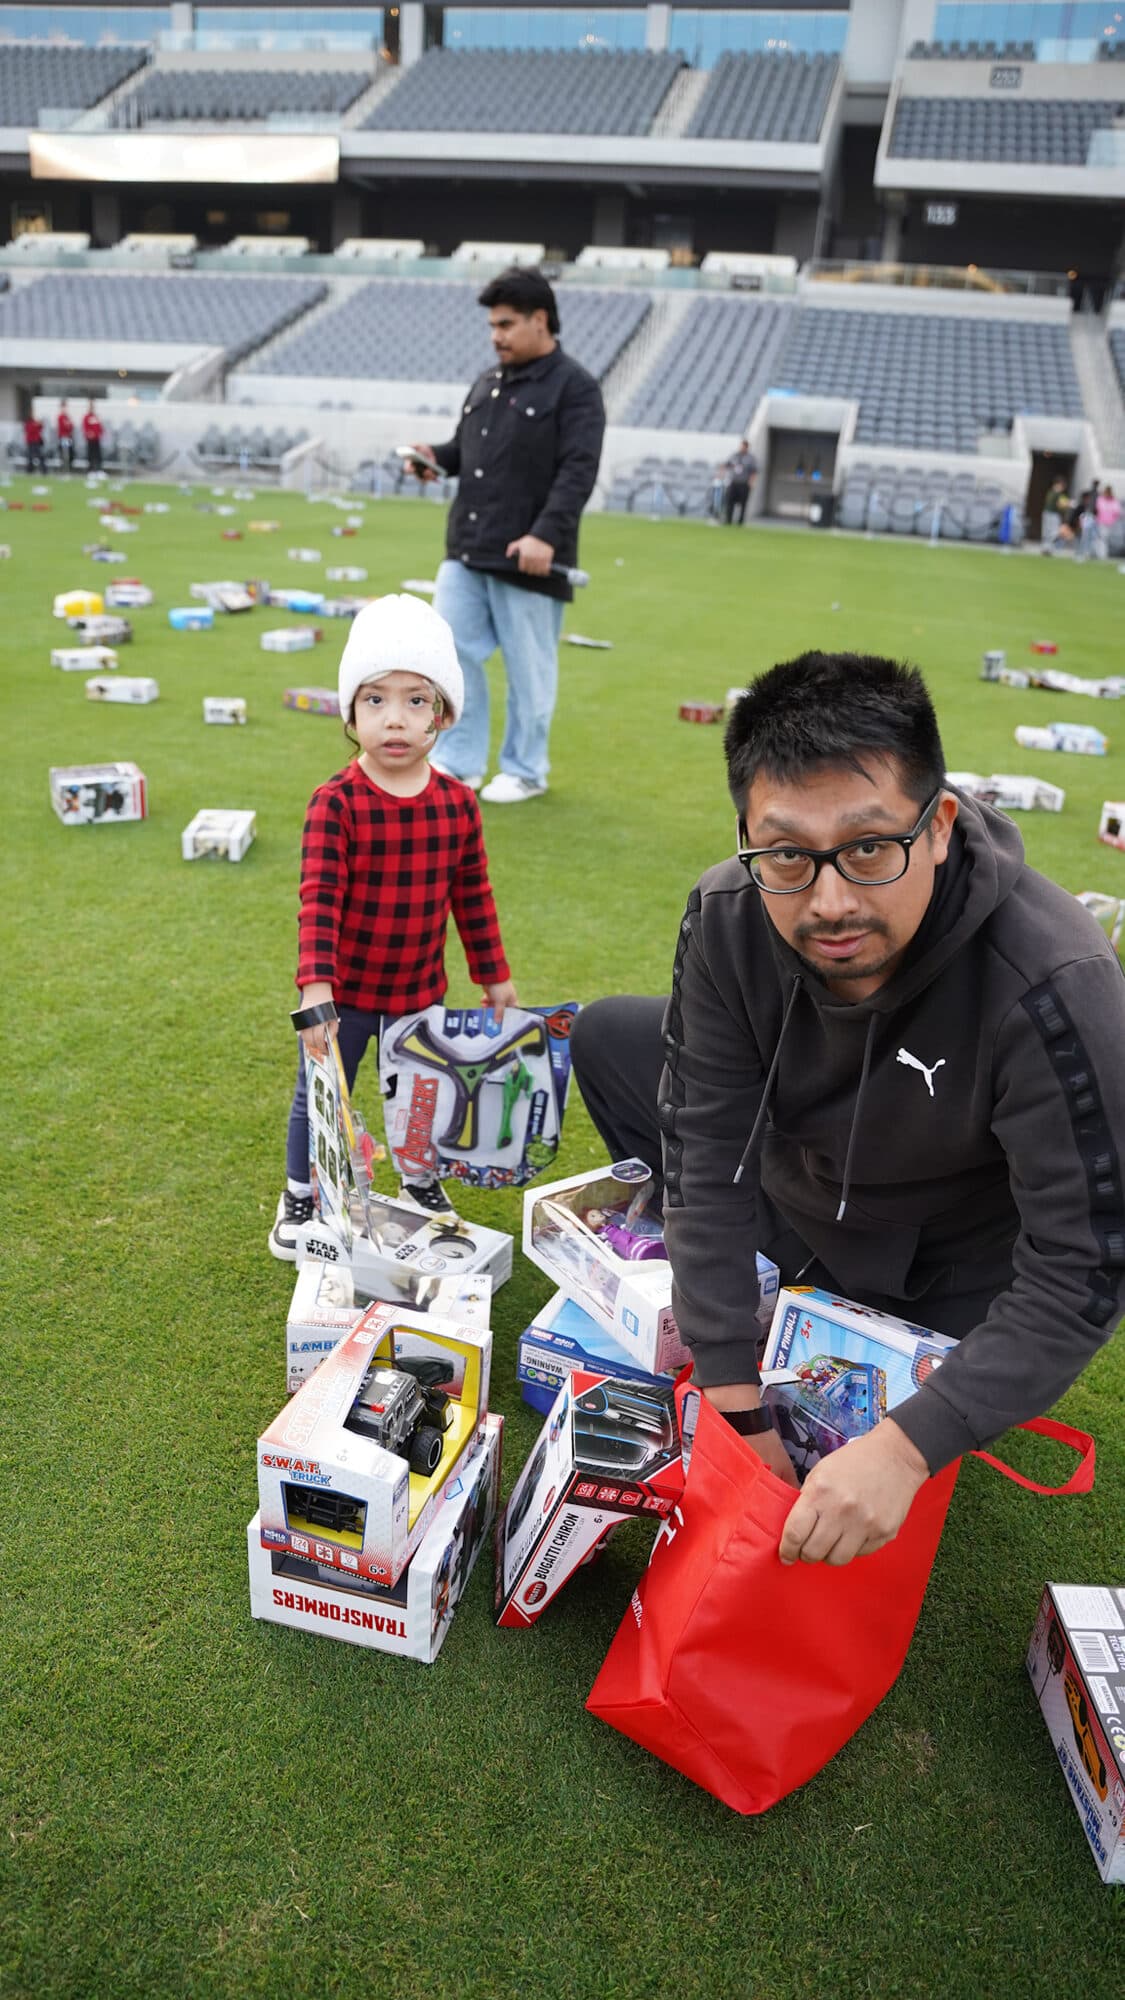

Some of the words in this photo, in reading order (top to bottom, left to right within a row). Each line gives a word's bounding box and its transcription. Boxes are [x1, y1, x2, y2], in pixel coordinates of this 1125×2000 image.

[392, 1072, 440, 1175] AVENGERS
[305, 1239, 339, 1255] STAR
[305, 1246, 338, 1261] WARS
[781, 1311, 797, 1350] PINBALL
[800, 1319, 813, 1339] 3+
[290, 1365, 304, 1374] 6+
[261, 1454, 320, 1475] S.W.A.T.
[290, 1471, 332, 1486] TRUCK
[594, 1514, 603, 1524] 6+
[534, 1545, 561, 1580] BUGATTI
[552, 1512, 580, 1546] CHIRON
[368, 1563, 387, 1575] 6+
[272, 1588, 408, 1639] TRANSFORMERS
[1066, 1761, 1102, 1836] MUSTANG
[1083, 1817, 1107, 1866] FORD
